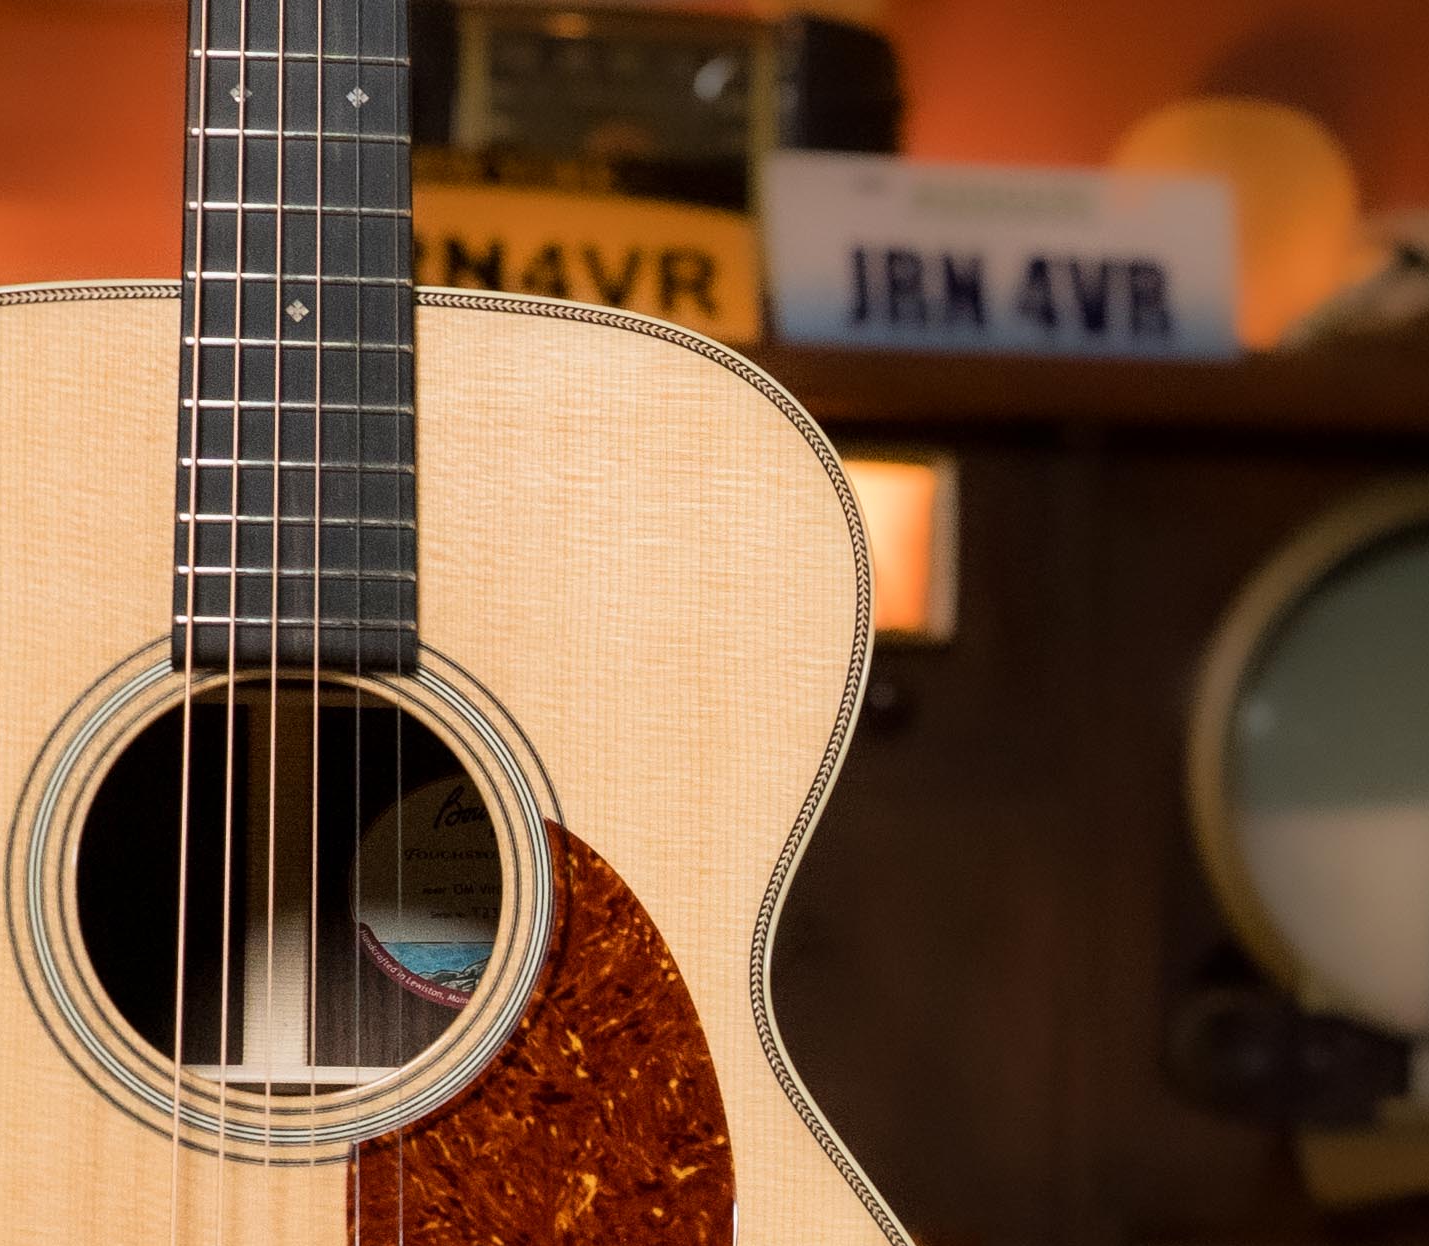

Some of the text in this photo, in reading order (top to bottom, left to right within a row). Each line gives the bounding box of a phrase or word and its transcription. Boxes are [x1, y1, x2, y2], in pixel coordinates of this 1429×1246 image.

[849, 244, 1172, 337] JRN 4VR
[360, 930, 399, 973] Handcrafted
[397, 971, 406, 981] in
[405, 976, 444, 1000] Lewiston,
